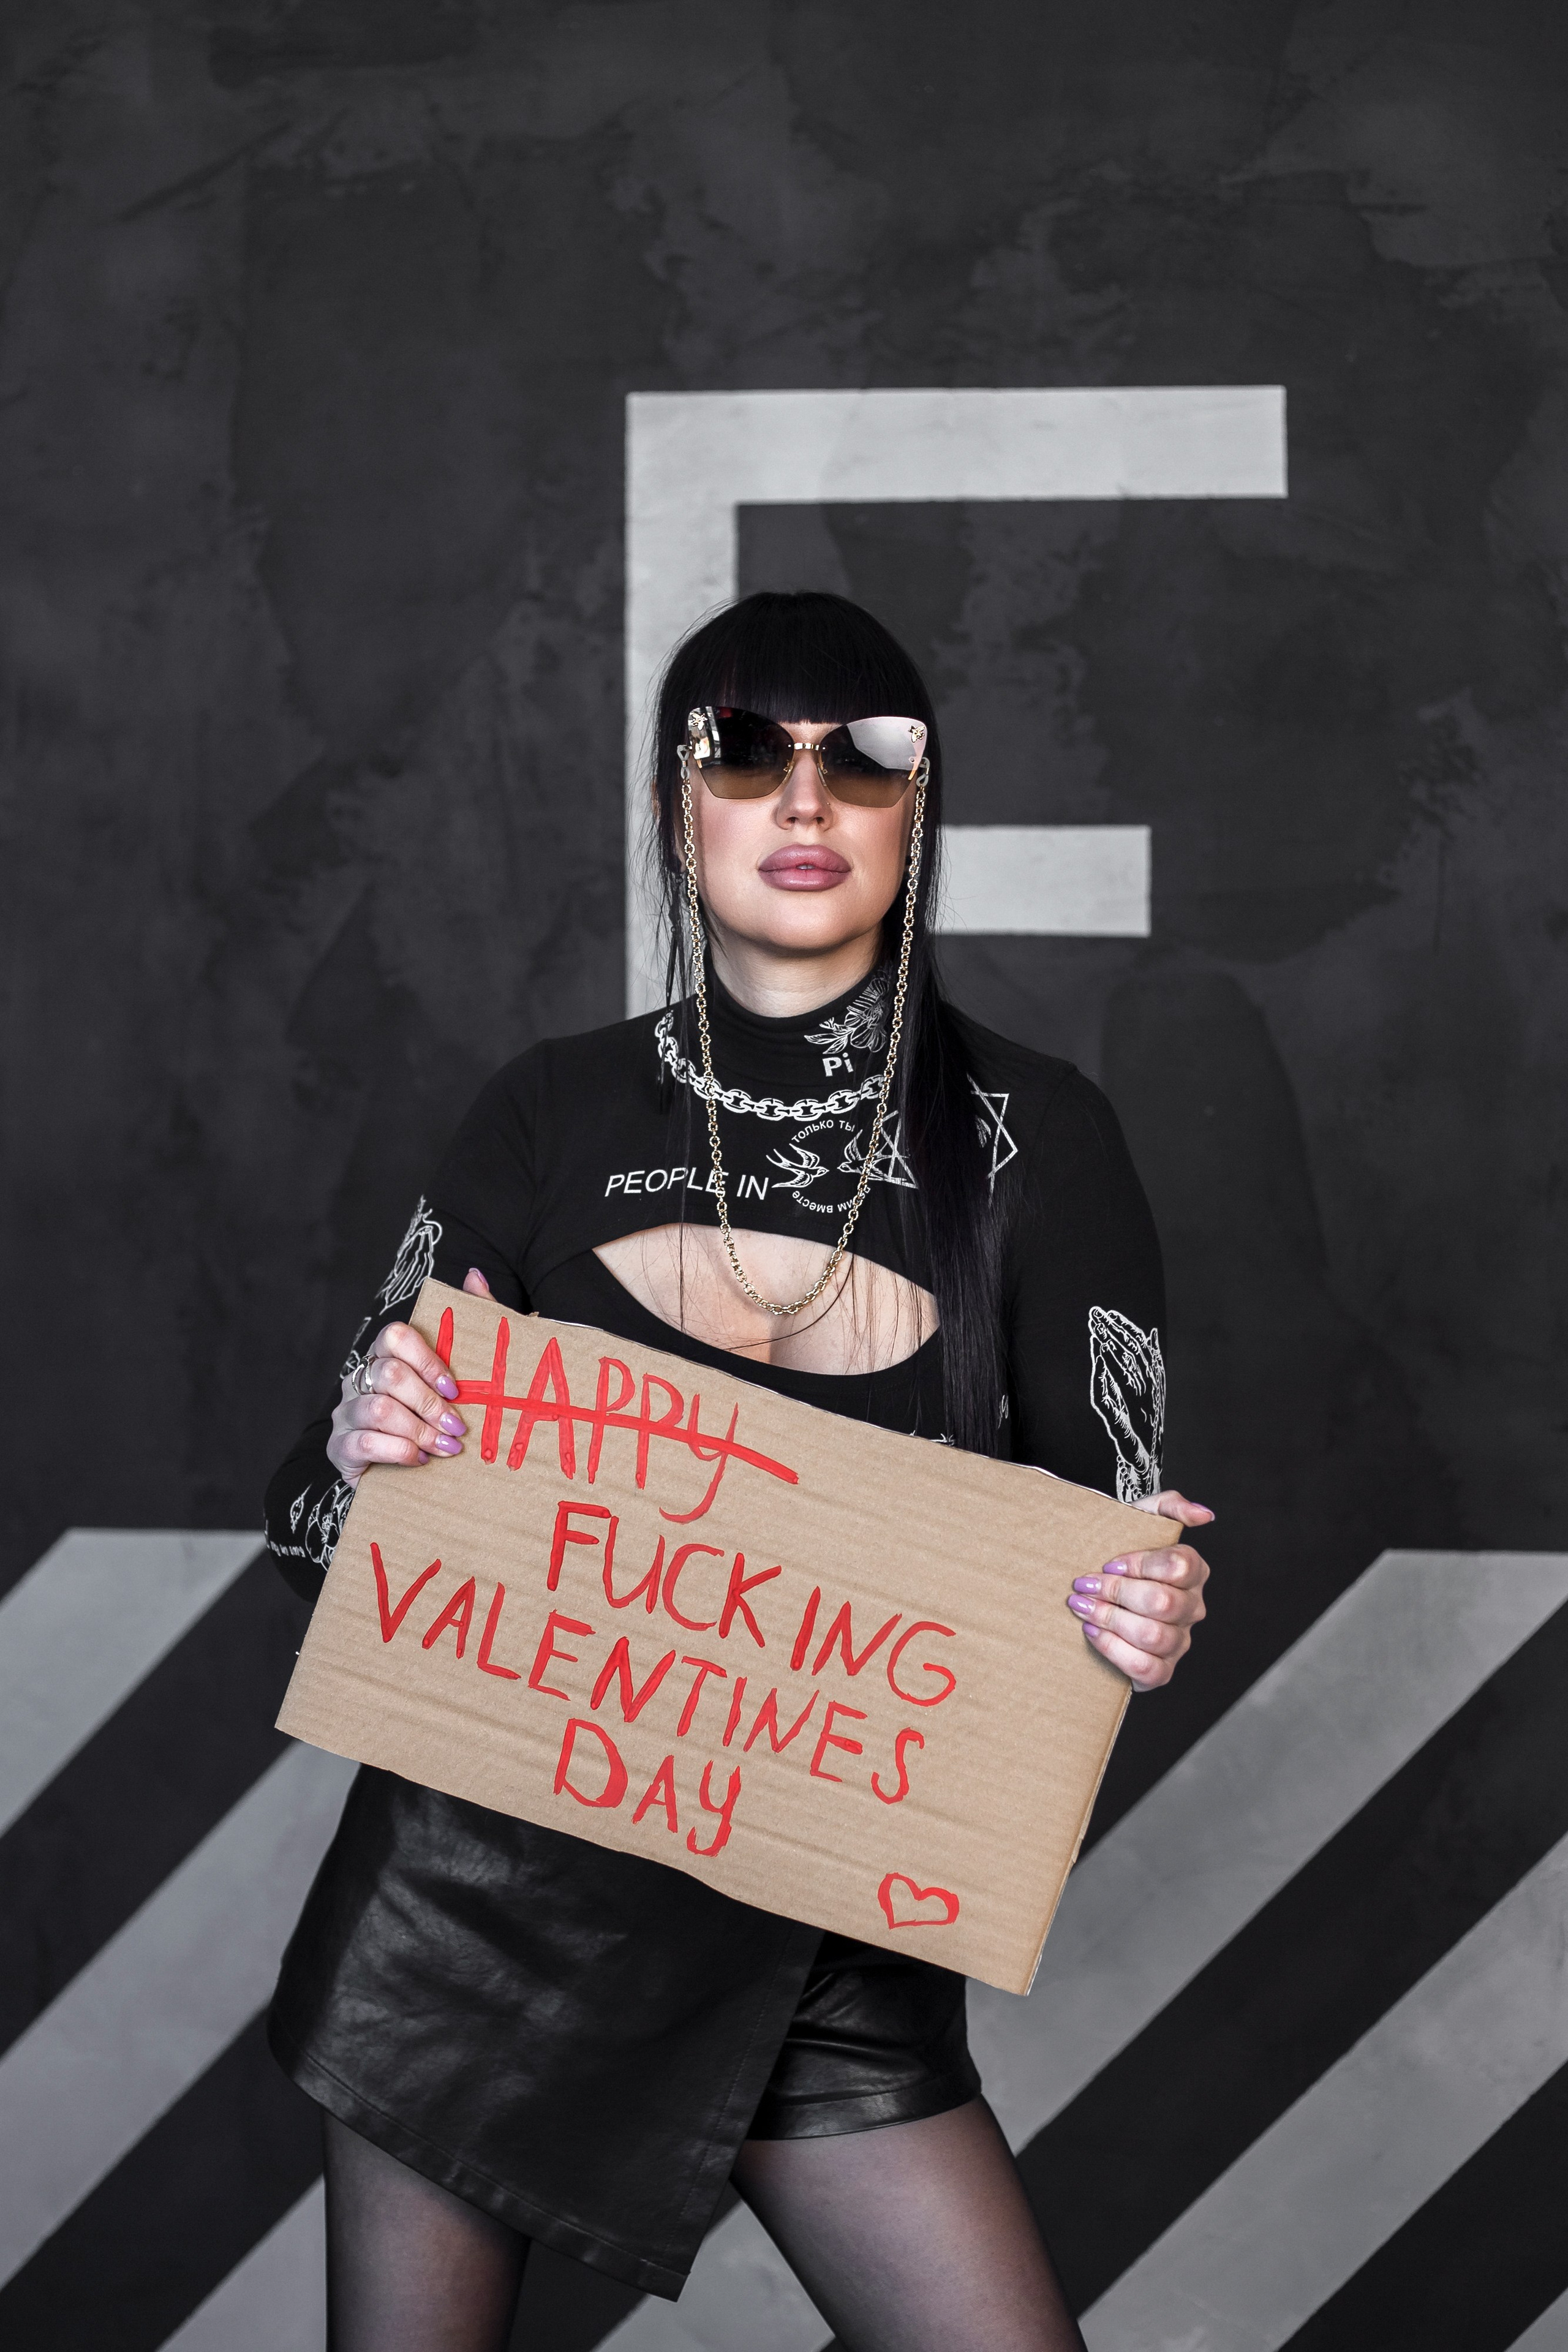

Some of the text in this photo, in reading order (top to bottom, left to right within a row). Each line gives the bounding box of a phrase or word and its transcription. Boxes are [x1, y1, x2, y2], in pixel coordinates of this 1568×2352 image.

[822, 1052, 854, 1077] Pi
[604, 1167, 769, 1200] PEOPLE IN
[546, 1500, 957, 1707] FUCKING
[370, 1542, 925, 1804] VALENTINES
